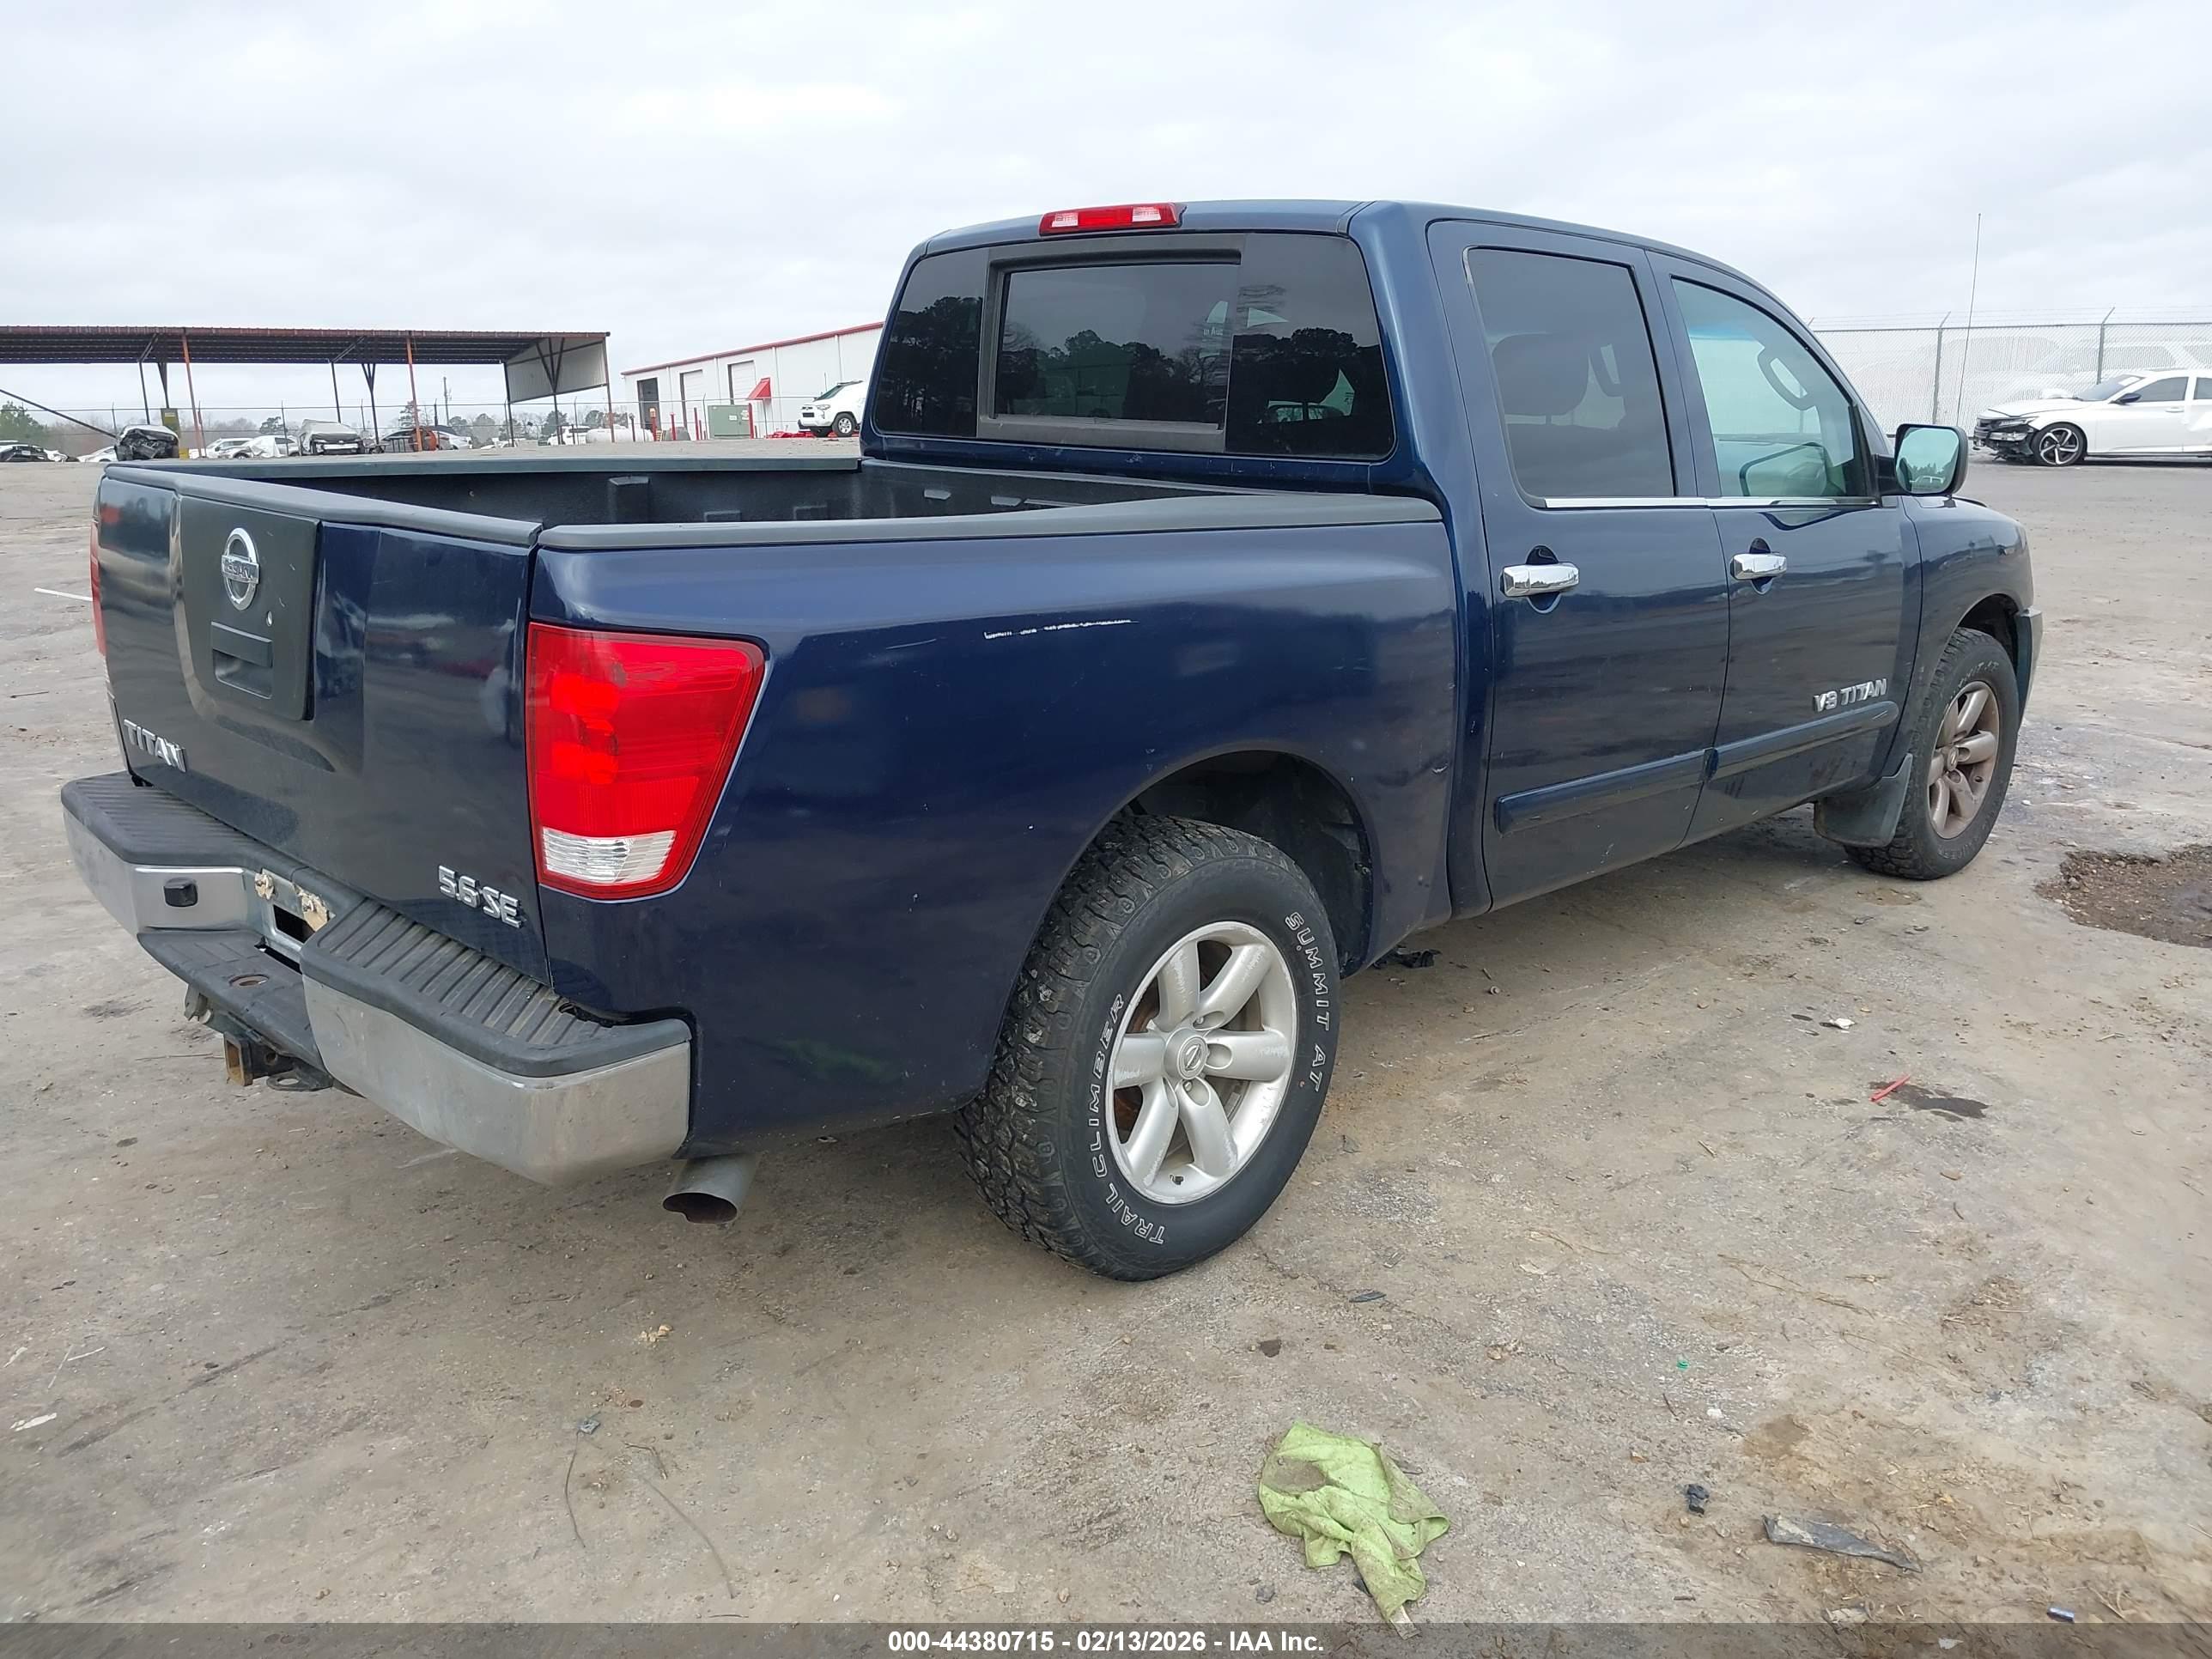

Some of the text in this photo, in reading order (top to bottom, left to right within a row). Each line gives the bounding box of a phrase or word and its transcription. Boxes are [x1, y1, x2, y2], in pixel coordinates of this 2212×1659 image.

[123, 719, 186, 773] TITAN
[1814, 678, 1887, 712] V8 TITAN
[1285, 911, 1329, 1092] SUMMIT AT
[1088, 993, 1165, 1244] TRAIL CLIMBER
